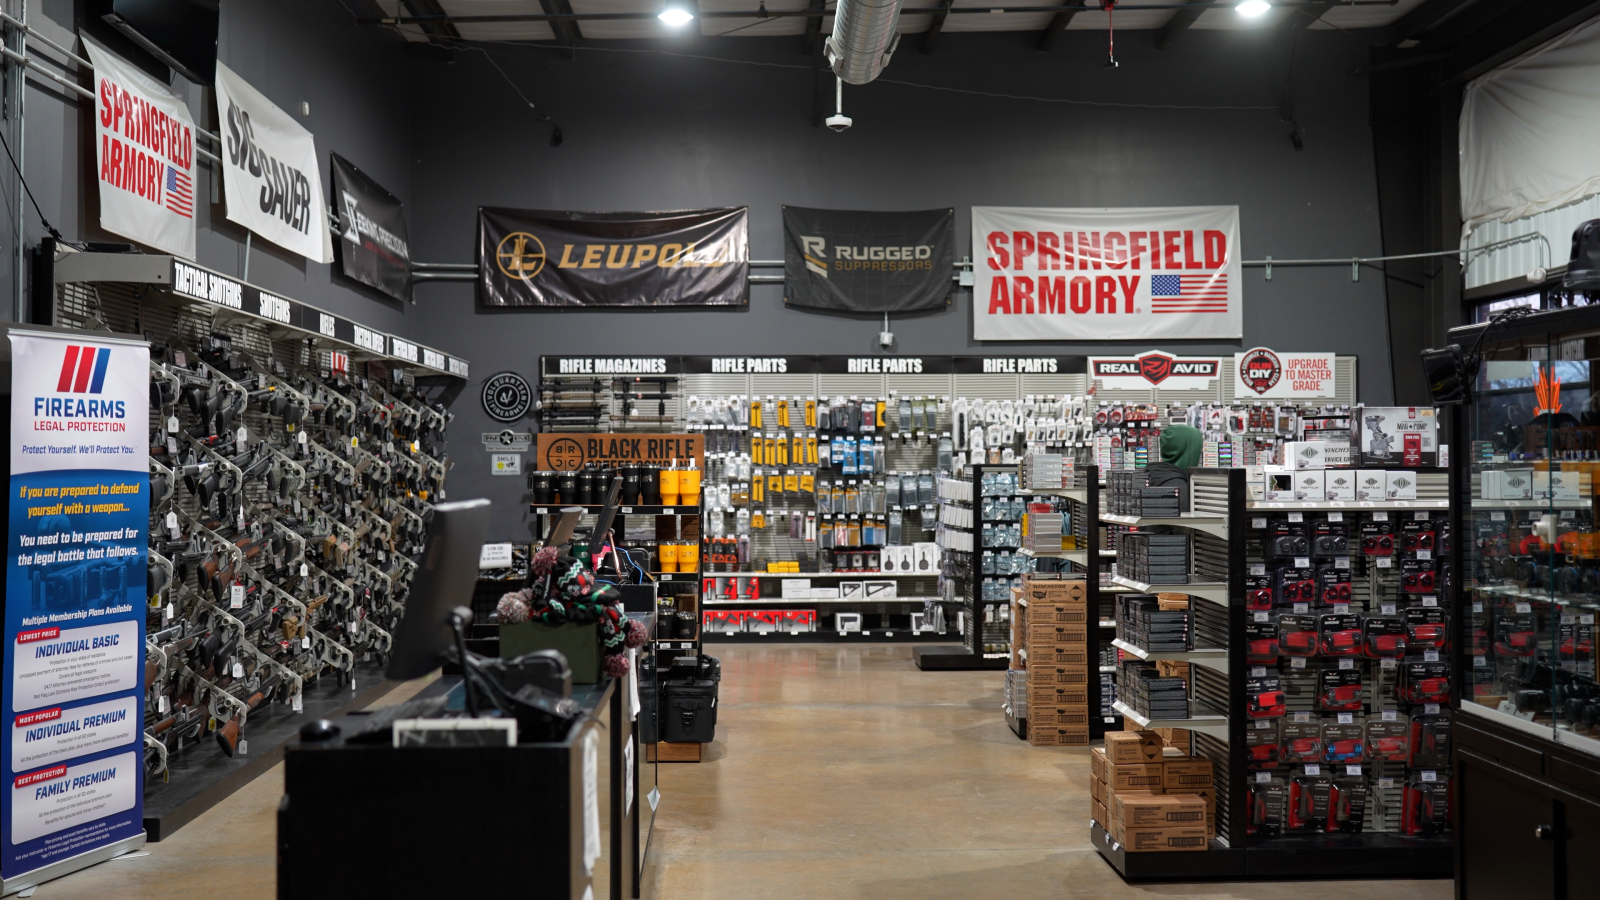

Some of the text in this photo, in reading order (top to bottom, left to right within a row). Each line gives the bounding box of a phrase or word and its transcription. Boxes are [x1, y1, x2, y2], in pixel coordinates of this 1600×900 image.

[100, 76, 193, 172] SPRINGFIELD
[226, 97, 262, 179] SIG
[101, 133, 163, 204] ARMORY
[259, 148, 312, 236] SAUER
[834, 244, 932, 260] RUGGED
[986, 230, 1228, 271] SPRINGFIELD
[834, 260, 933, 271] SUPPRESSORS
[174, 262, 242, 310] TACTICAL SHOTGUNS
[987, 275, 1141, 315] ARMORY
[259, 291, 291, 324] SHOTGUNS
[559, 358, 667, 373] RIFLE MAGAZINES
[711, 358, 787, 373] RIFLE PARTS
[847, 358, 923, 373] RIFLE PARTS
[983, 358, 1058, 373] RIFLE PARTS
[1100, 363, 1212, 373] REAL AVID
[1288, 359, 1328, 369] UPGRADE
[1249, 369, 1273, 378] DIY
[1285, 370, 1332, 380] TO MASTER
[487, 377, 527, 401] VOLQUARTSEN
[1293, 381, 1324, 391] GRADE.
[34, 397, 126, 419] FIREARMS
[489, 404, 524, 417] FIREARMS
[34, 420, 126, 432] LEGAL PROTECTION
[22, 445, 46, 454] Protect
[48, 445, 77, 454] Yourself.
[79, 445, 94, 454] We'll
[96, 445, 120, 454] Protect
[587, 438, 695, 459] BLACK RIFLE
[20, 483, 140, 500] If you are prepared to defend
[28, 503, 130, 519] yourself with a weapon...
[20, 527, 139, 547] You need to be prepared for
[18, 546, 139, 566] the legal battle that follows.
[22, 604, 133, 627] Multiple Membership Plans Available
[20, 632, 40, 641] LOWEST
[35, 634, 120, 659] INDIVIDUAL BASIC
[19, 710, 59, 724] MOST POPULAR
[25, 709, 126, 743] INDIVIDUAL PREMIUM
[17, 768, 65, 785] BEST PROTECTION
[35, 767, 116, 800] FAMILY PREMIUM
